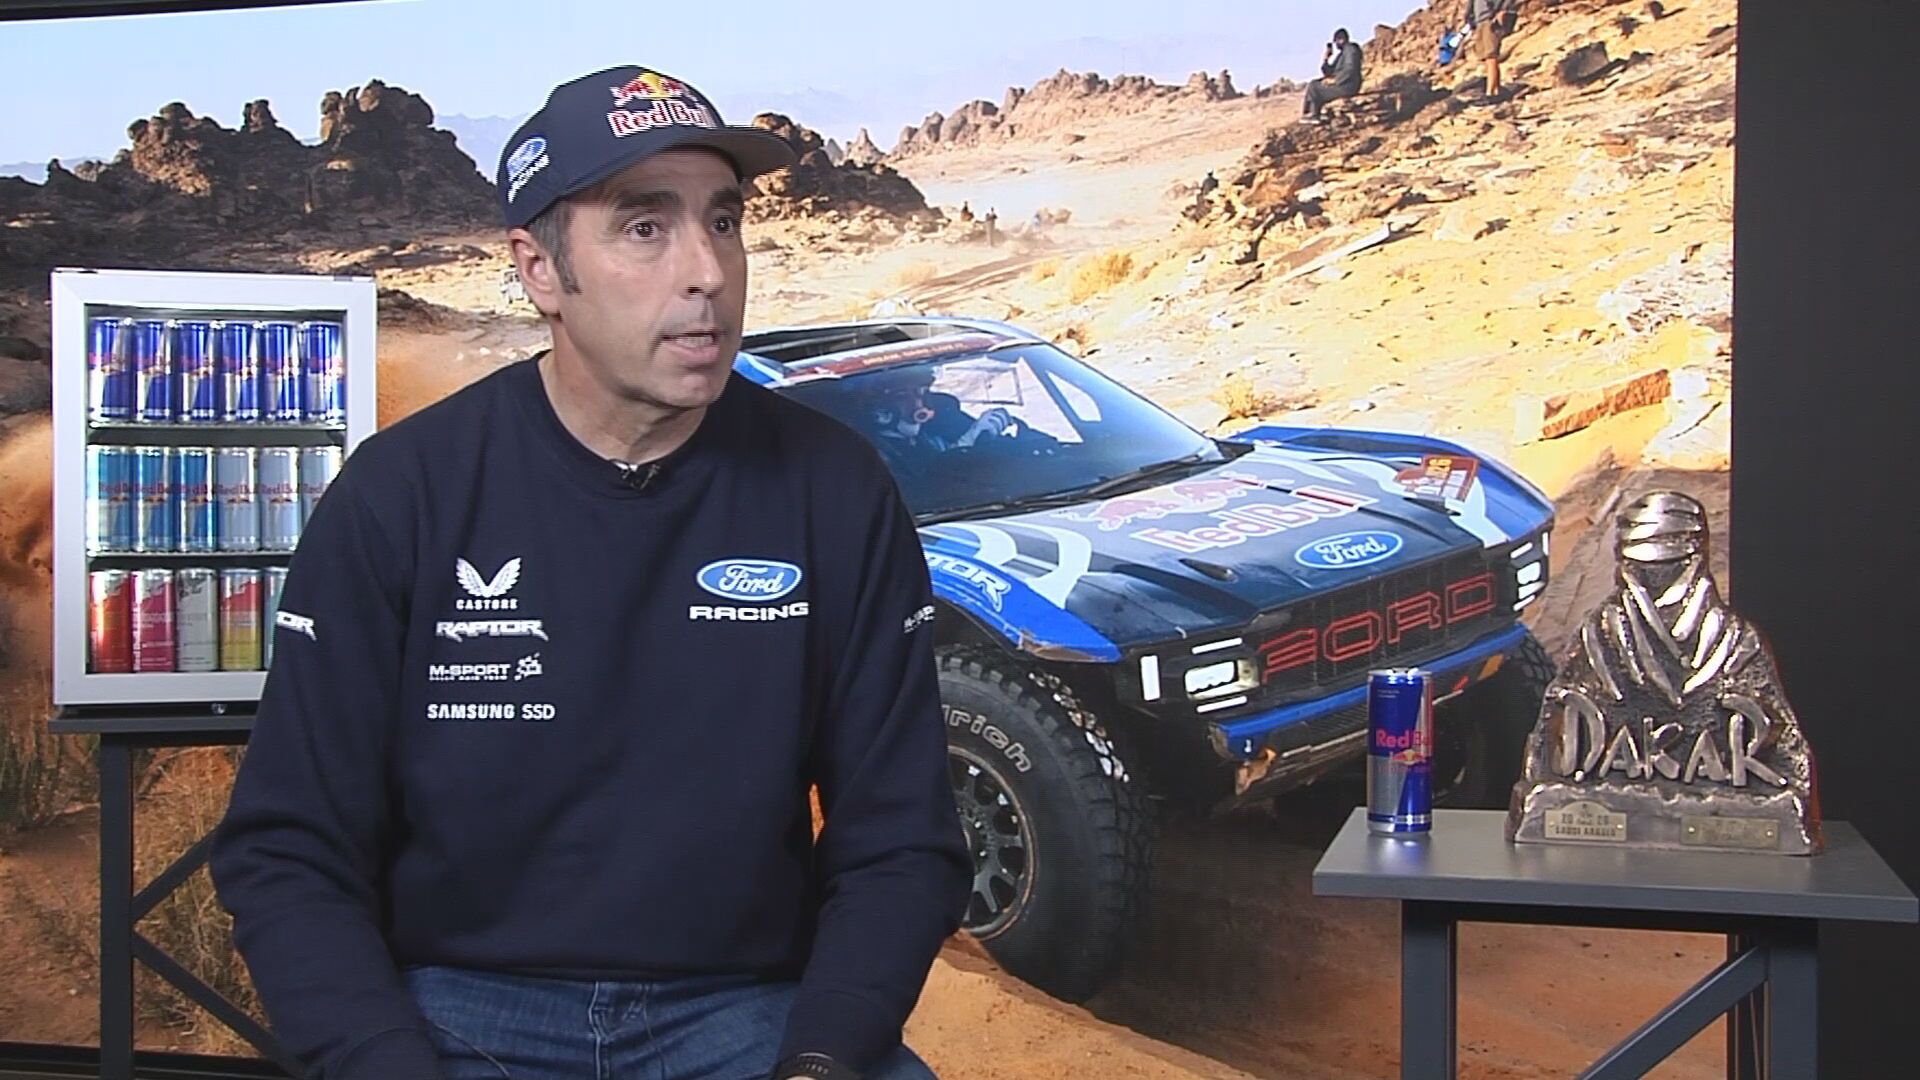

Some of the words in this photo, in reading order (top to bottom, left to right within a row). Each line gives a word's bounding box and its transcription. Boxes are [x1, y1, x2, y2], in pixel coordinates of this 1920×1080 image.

[607, 101, 674, 138] Red
[1313, 536, 1388, 564] Ford
[718, 564, 784, 593] Ford
[922, 550, 1012, 613] TOR
[455, 598, 518, 610] CASTORE
[690, 602, 810, 621] RACING
[435, 619, 550, 643] RAPTOR
[1256, 572, 1498, 685] FORD
[429, 663, 511, 676] M-SPORT
[427, 704, 515, 719] SAMSUNG
[521, 704, 556, 720] SSD
[1376, 728, 1410, 748] Red
[1558, 688, 1789, 788] DAKAR
